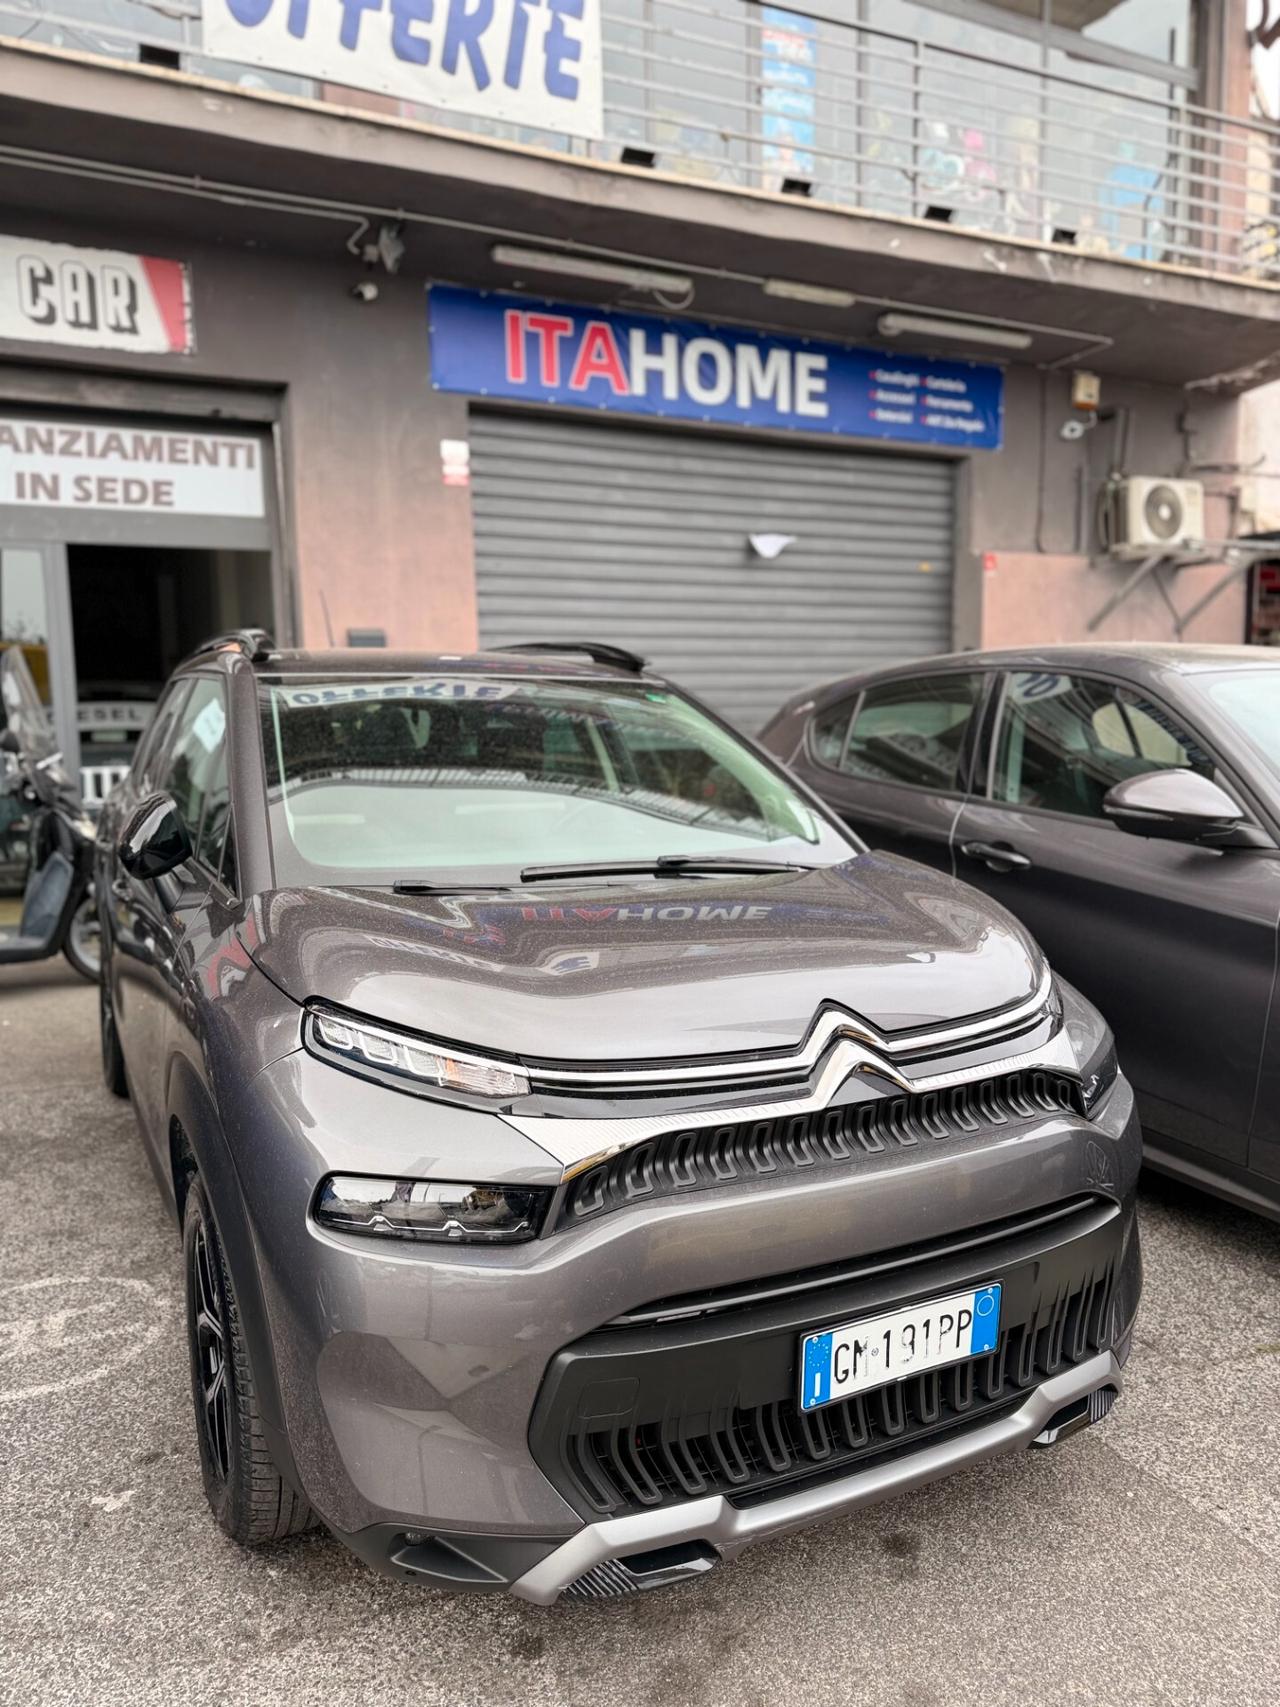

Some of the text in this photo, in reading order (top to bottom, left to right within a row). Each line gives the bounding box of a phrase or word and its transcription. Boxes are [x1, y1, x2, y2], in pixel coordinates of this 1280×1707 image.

[16, 253, 140, 336] CAR
[505, 309, 829, 417] ITAHOME
[15, 472, 174, 507] IN SEDE
